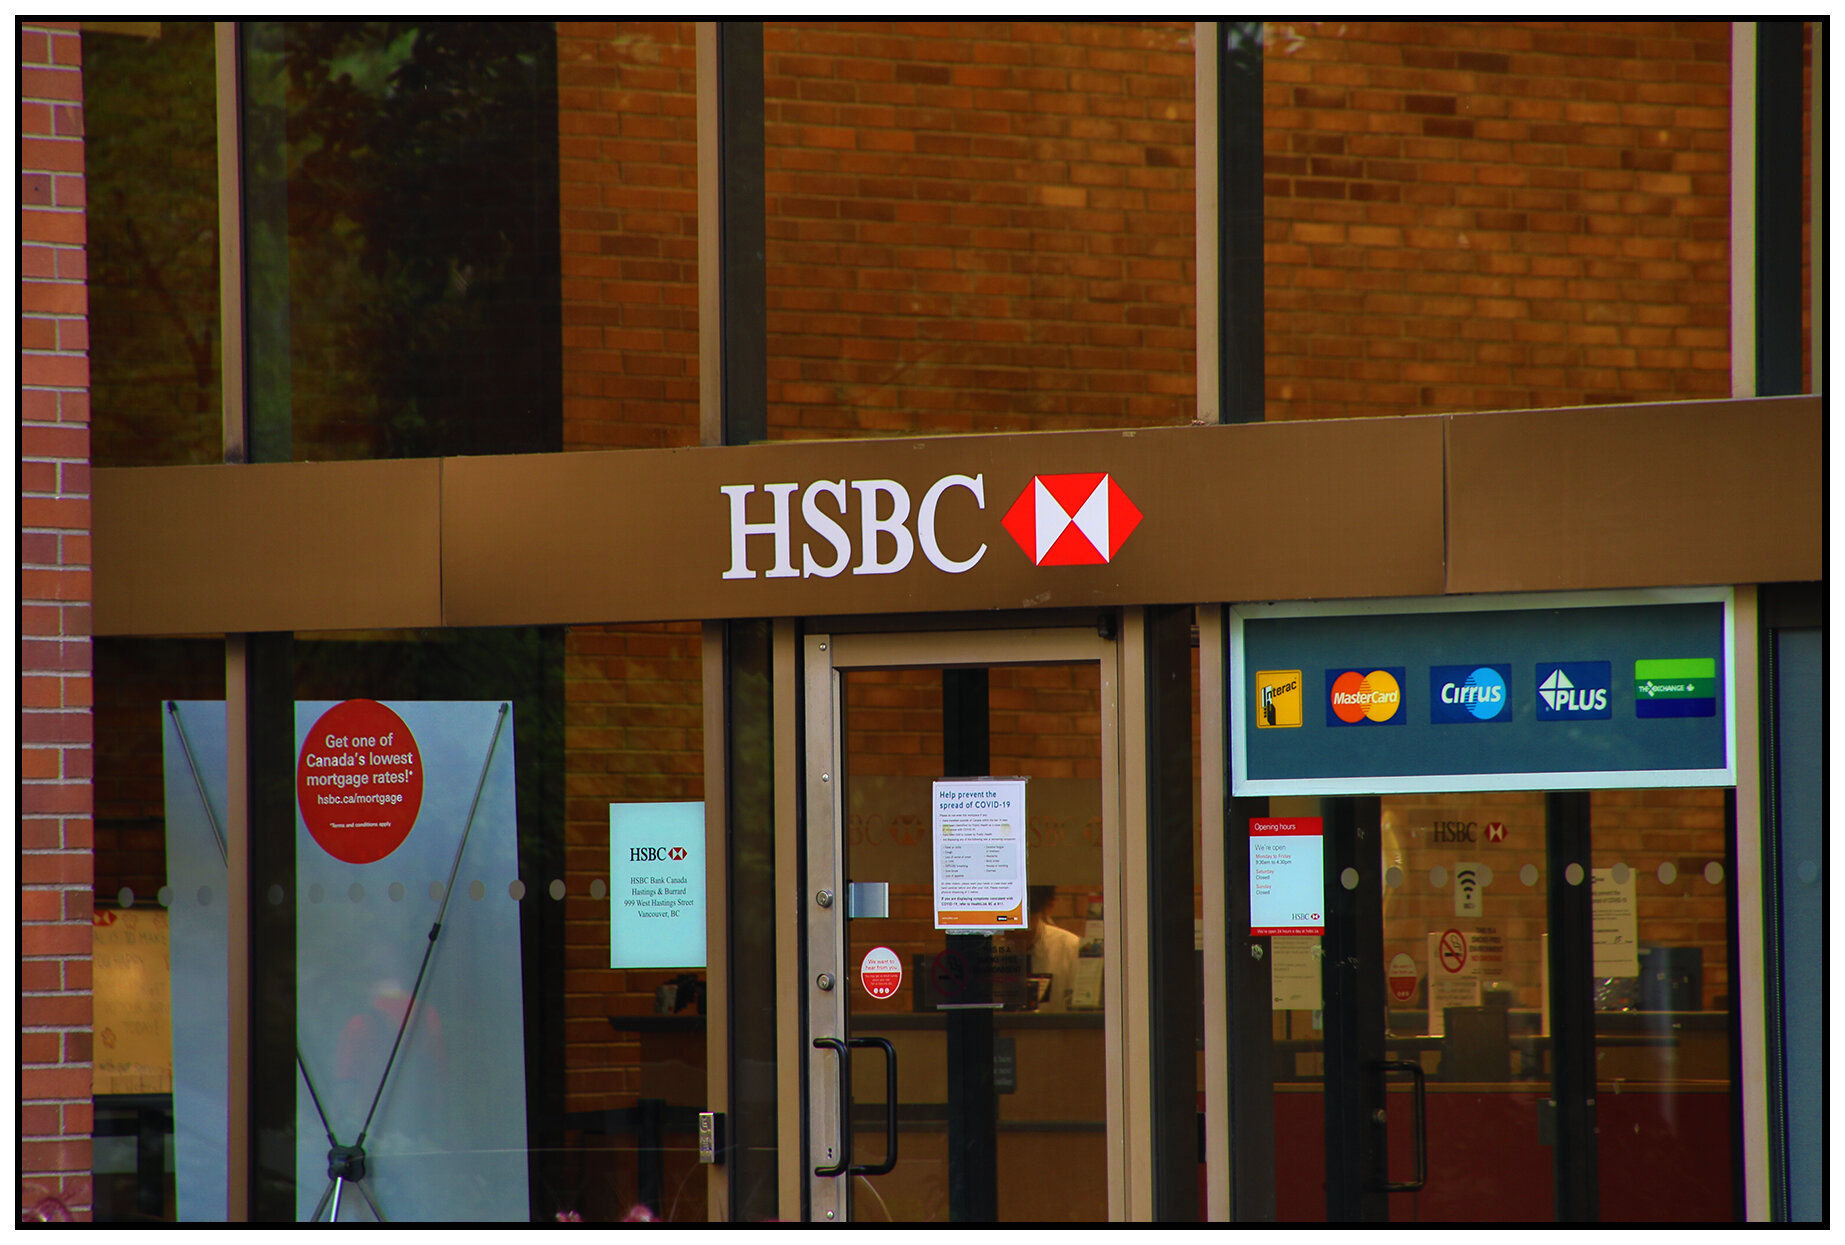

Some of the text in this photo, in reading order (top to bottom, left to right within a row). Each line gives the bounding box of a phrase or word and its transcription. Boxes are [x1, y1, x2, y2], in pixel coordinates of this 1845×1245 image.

[720, 473, 988, 579] HSBC
[1263, 681, 1297, 708] Interac
[1333, 688, 1399, 705] MasterCard
[1440, 682, 1502, 705] Cirrus
[1555, 687, 1607, 711] PLUS
[325, 732, 394, 748] Get one of
[306, 752, 413, 767] Canada's lowest
[306, 773, 369, 788] mortgage
[317, 793, 403, 805] hsbc.ca/mortgage
[939, 790, 996, 799] Help prevent the
[939, 801, 963, 810] spread
[974, 801, 1011, 809] COVID-19
[1254, 823, 1279, 831] Opening
[1433, 821, 1478, 842] HSBC
[630, 847, 667, 862] HSBC
[630, 876, 688, 885] HSBC Bank Canada
[631, 888, 656, 897] Hastings
[664, 887, 687, 895] Burrard
[636, 899, 651, 907] West
[651, 899, 676, 908] Hastings
[677, 899, 694, 907] Street
